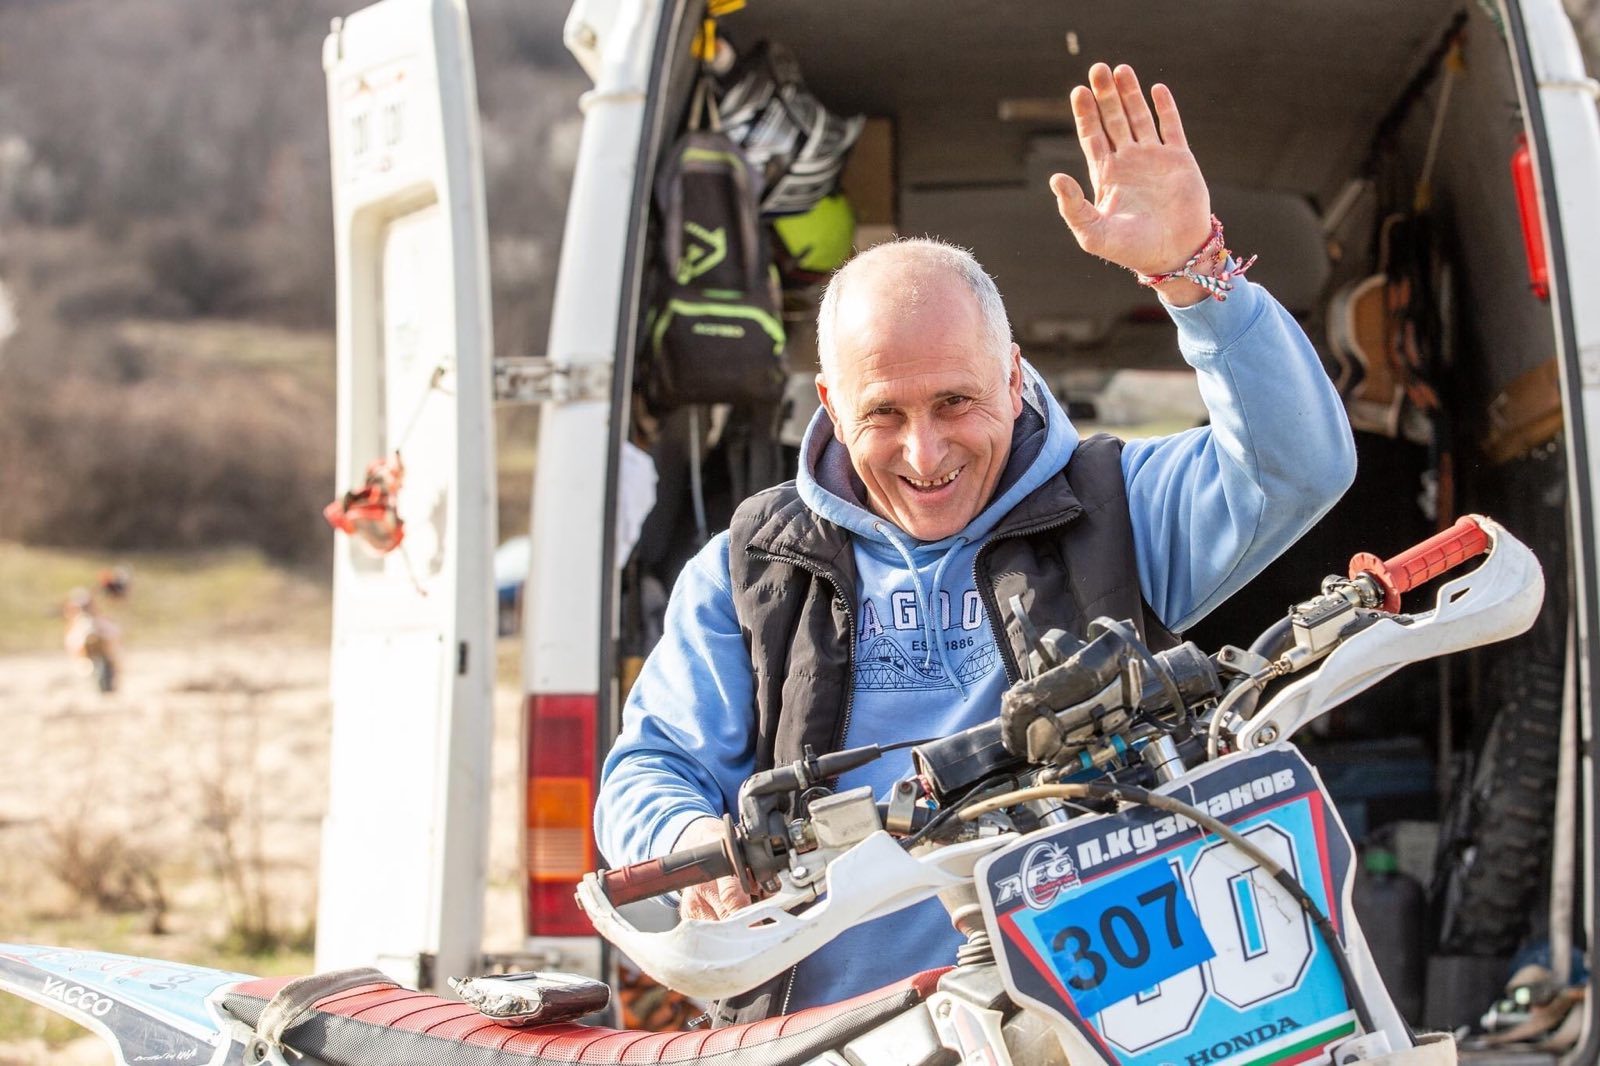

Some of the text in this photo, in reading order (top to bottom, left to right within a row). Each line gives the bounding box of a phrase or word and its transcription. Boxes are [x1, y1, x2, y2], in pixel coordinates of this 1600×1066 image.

[945, 636, 974, 651] 1886
[1052, 882, 1184, 991] 307
[39, 976, 114, 1017] YACCO
[1185, 1016, 1302, 1066] HONDA
